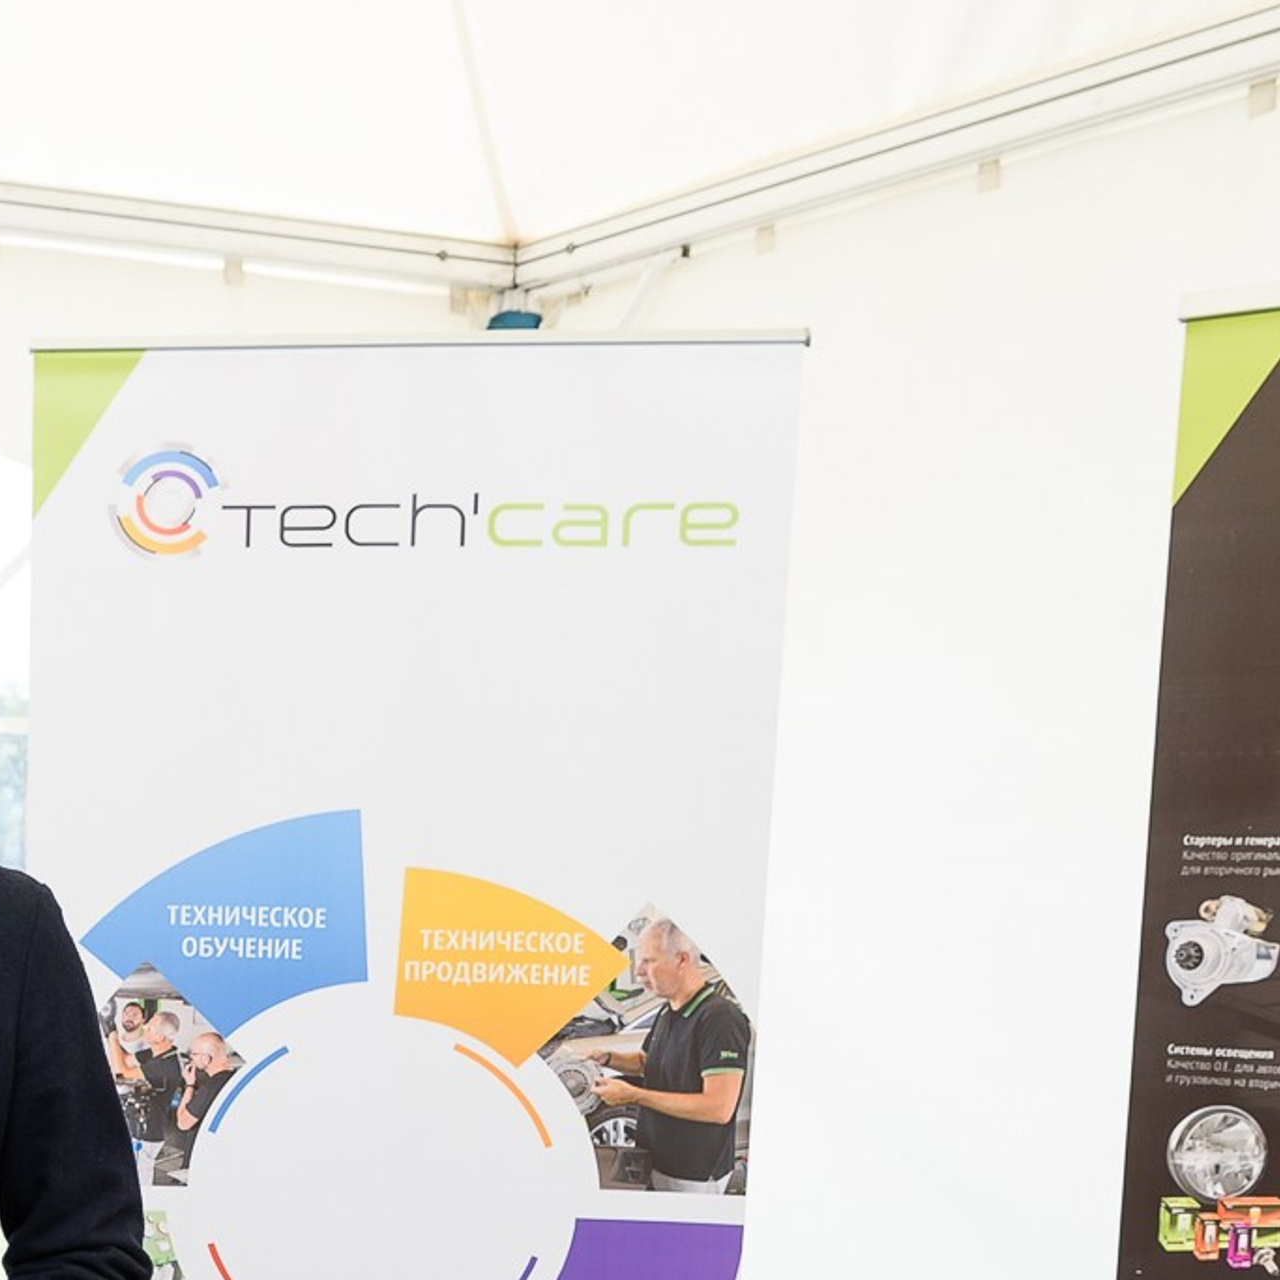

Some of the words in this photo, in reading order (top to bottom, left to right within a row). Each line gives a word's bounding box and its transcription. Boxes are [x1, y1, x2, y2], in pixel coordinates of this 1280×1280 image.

[167, 902, 327, 930] ТЕХНИЧЕСКОЕ
[181, 935, 303, 962] ОБУЧЕНИЕ
[420, 928, 585, 956] ТЕХНИЧЕСКОЕ
[404, 956, 590, 988] ПРОДВИЖЕНИЕ
